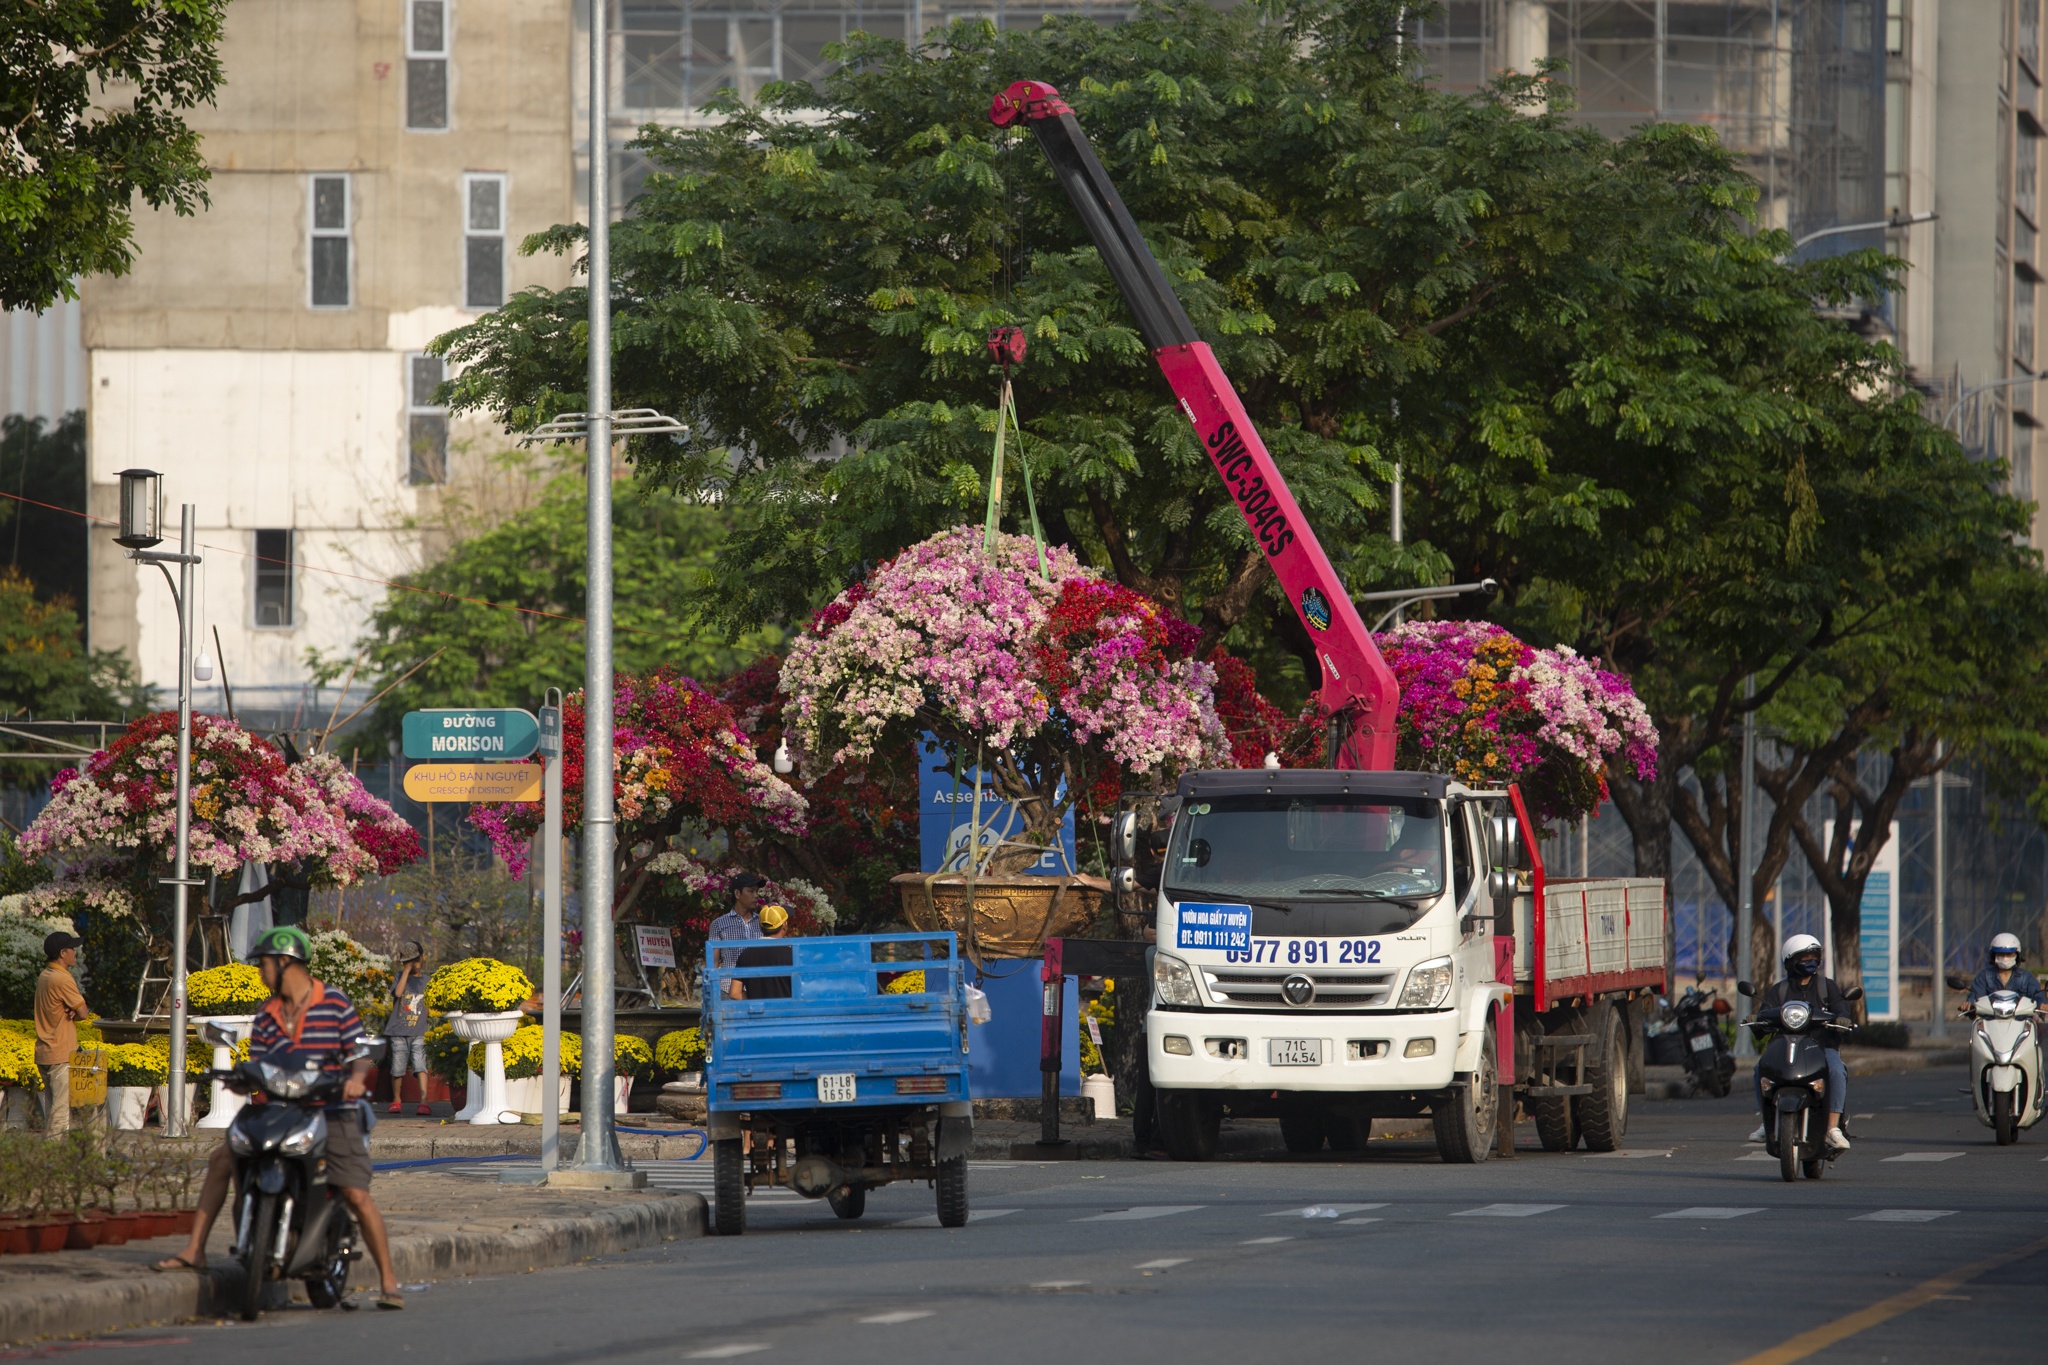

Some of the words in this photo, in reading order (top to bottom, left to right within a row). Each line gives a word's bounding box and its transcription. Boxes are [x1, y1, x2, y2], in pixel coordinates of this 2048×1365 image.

[1208, 421, 1294, 557] SWC-304CS
[443, 714, 496, 728] ĐƯỜNG
[432, 736, 504, 752] MORISON
[414, 772, 436, 782] KHU
[439, 768, 457, 782] HỒ
[486, 770, 529, 784] NGUYỆT
[429, 786, 476, 795] CRESCENT
[477, 786, 515, 795] DISTRICT
[1197, 912, 1209, 925] HOA
[1209, 909, 1223, 926] GIẤY
[1223, 914, 1228, 925] 7
[1227, 912, 1247, 929] HUYỆN
[640, 936, 645, 946] 7
[1181, 929, 1193, 945] ĐT:
[1194, 931, 1213, 946] 0911
[1215, 932, 1229, 946] 111
[1230, 932, 1246, 947] 242
[1287, 940, 1329, 964] 891
[1339, 940, 1381, 964] 292
[175, 999, 181, 1009] 5
[1285, 1040, 1307, 1051] 71C
[1278, 1052, 1316, 1063] 114.54
[823, 1076, 851, 1088] 61-L8
[823, 1089, 852, 1101] 1656
